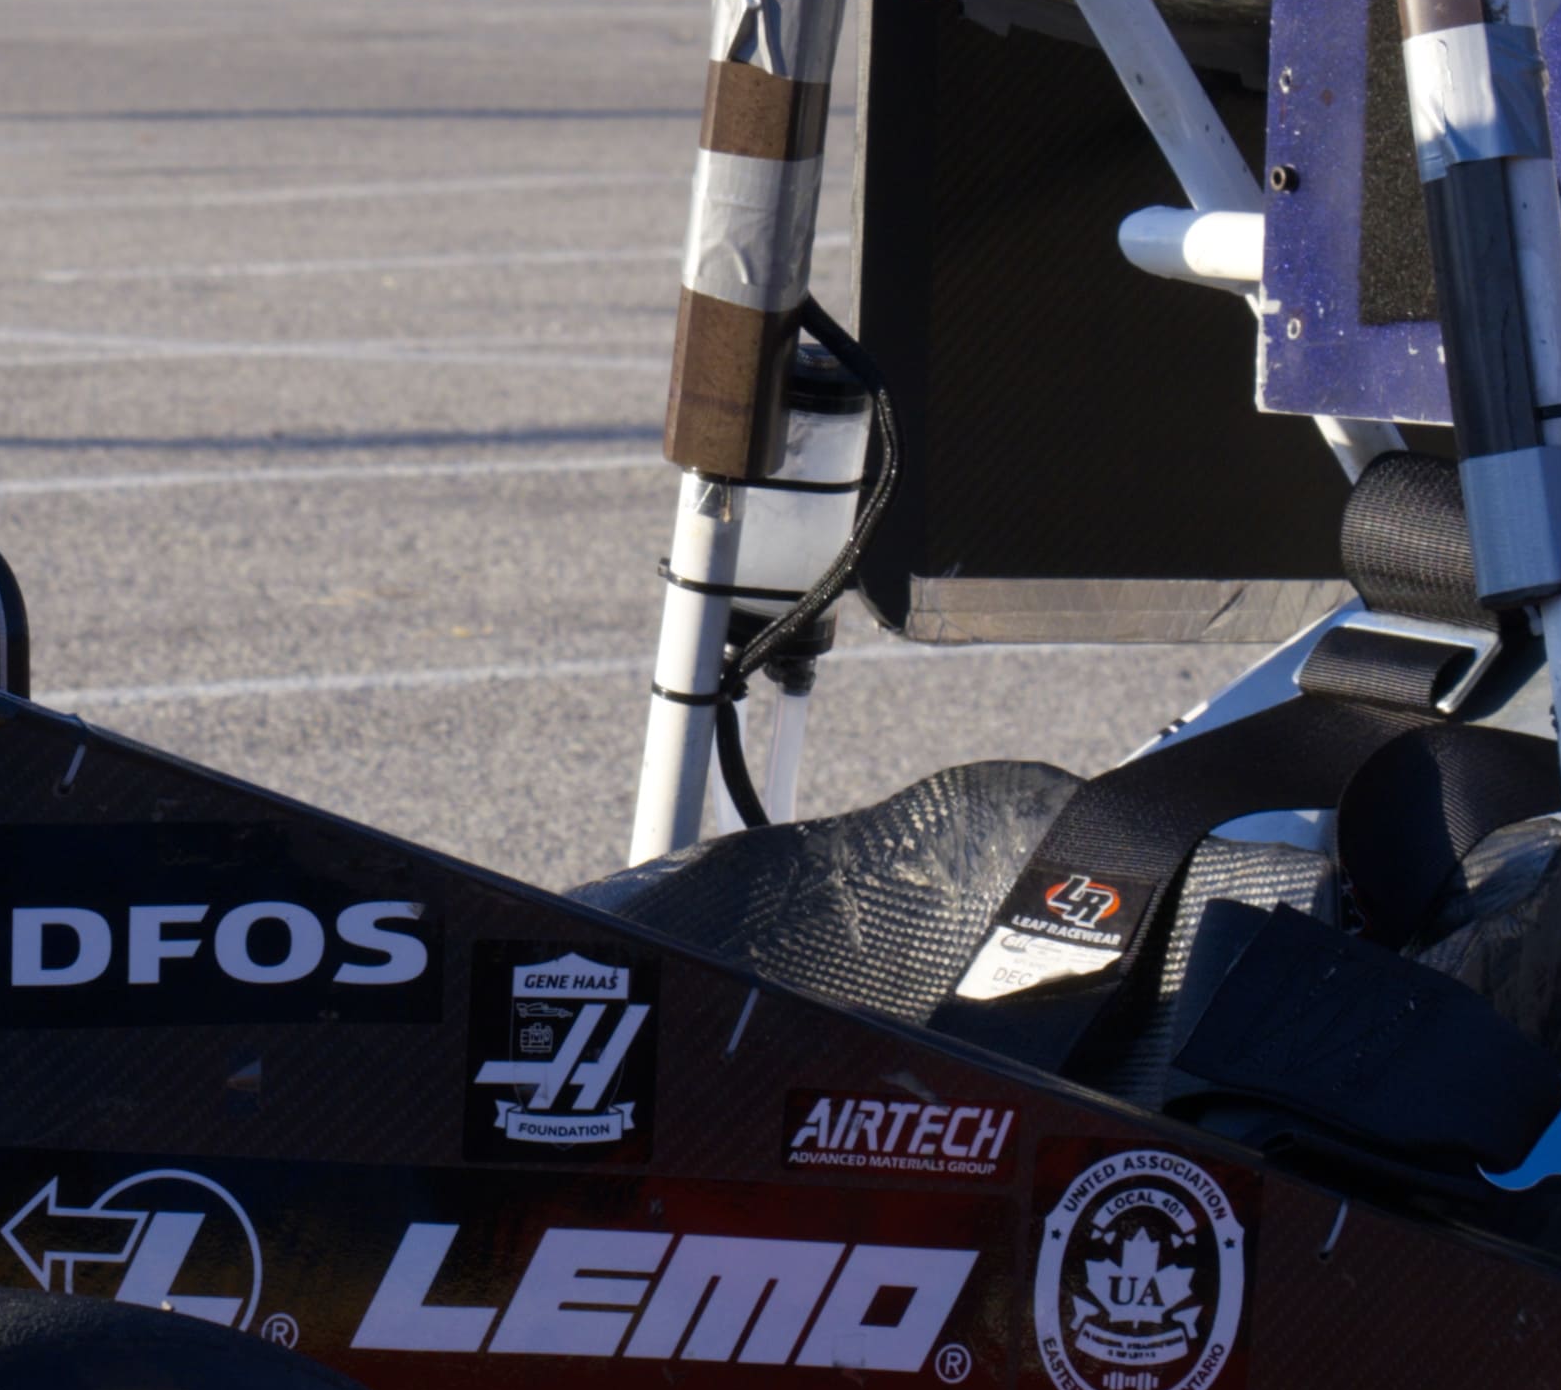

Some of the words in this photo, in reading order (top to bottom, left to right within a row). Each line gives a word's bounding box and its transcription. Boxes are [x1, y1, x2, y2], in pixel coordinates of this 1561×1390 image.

[1011, 914, 1047, 932] LEAF
[1046, 921, 1122, 947] RACEWEAR
[524, 974, 568, 989] GENE
[572, 975, 619, 991] HAAS
[518, 1122, 611, 1138] FOUNDATION
[790, 1097, 1014, 1159] AIRTECH
[788, 1151, 866, 1166] ADVANCED
[869, 1155, 945, 1172] MATERIALS
[947, 1160, 997, 1174] GROUP
[1064, 1163, 1116, 1212] UNITED
[1123, 1155, 1227, 1221] ASSOCIATION
[1106, 1190, 1155, 1216] LOCAL
[1161, 1198, 1185, 1218] 401
[350, 1221, 980, 1373] LEMO
[1108, 1275, 1164, 1308] UA
